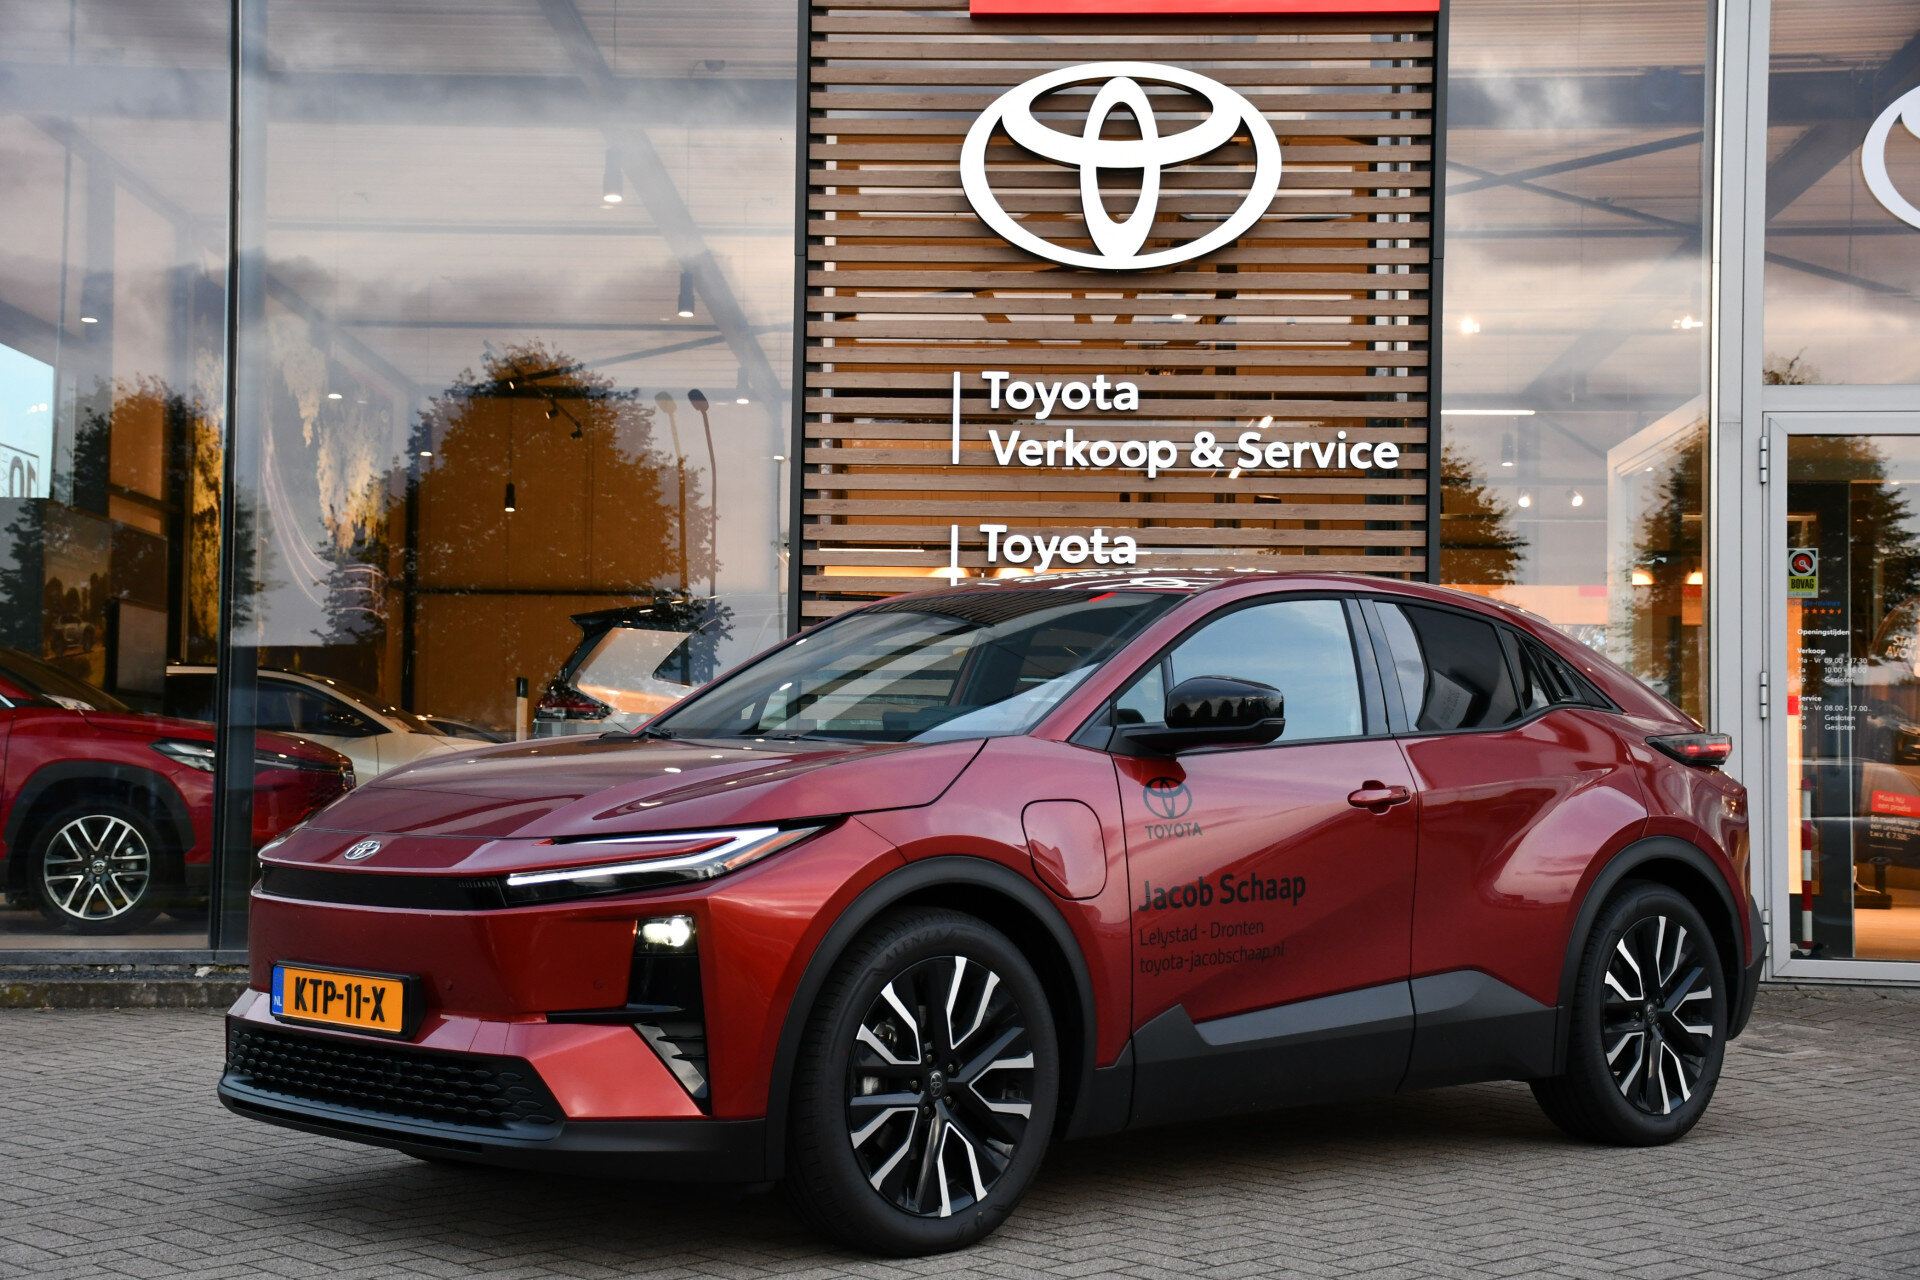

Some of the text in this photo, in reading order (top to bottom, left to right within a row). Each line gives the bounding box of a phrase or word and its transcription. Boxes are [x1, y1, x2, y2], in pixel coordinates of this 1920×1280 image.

[982, 371, 1139, 419] Toyota
[988, 429, 1400, 478] Verkoop & Service
[979, 524, 1137, 573] Toyota
[1791, 578, 1815, 589] BOVAG
[1145, 822, 1203, 839] TOYOTA
[1138, 873, 1306, 911] Jacob Schaap
[1139, 923, 1198, 949] Lelystad
[1210, 920, 1264, 939] Dronten
[1140, 941, 1285, 976] toyota-jacobschaap.nl
[273, 995, 283, 1006] NL
[294, 976, 386, 1022] KTP-11-X
